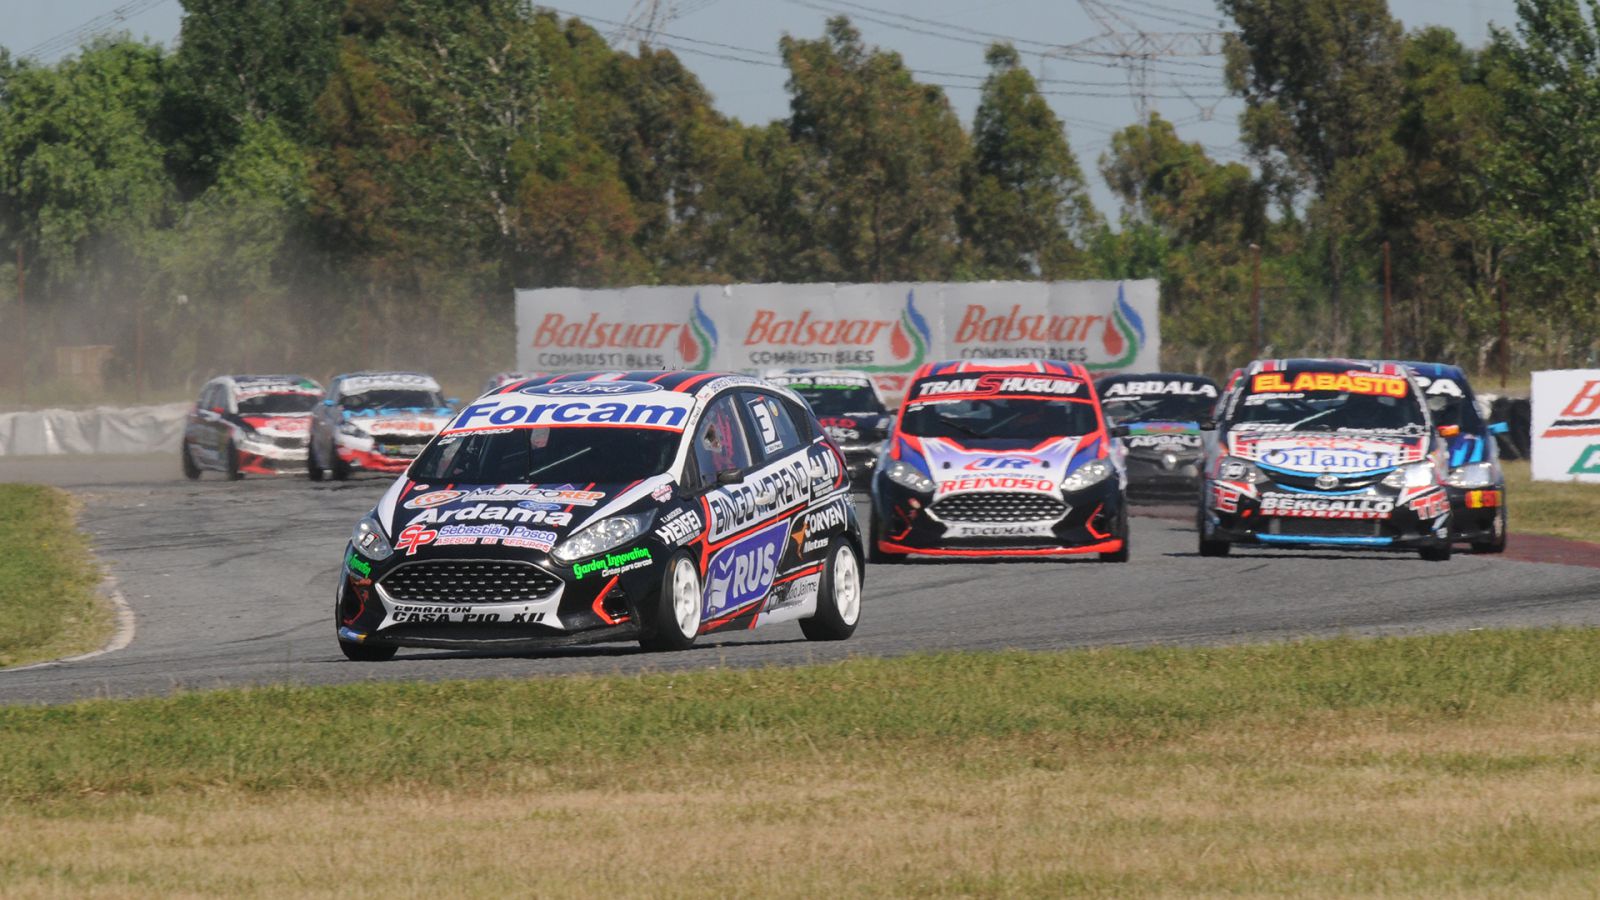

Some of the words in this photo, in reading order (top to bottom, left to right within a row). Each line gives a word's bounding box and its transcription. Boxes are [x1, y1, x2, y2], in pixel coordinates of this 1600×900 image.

[532, 312, 682, 348] Balsuar
[743, 310, 891, 346] Balsuar
[953, 304, 1104, 344] Balsuar
[538, 351, 664, 367] COMBUSTIBLES
[750, 350, 875, 365] COMBUSTIBLES
[961, 347, 1089, 362] COMBUSTIBLES
[548, 382, 627, 393] Ford
[1103, 380, 1218, 398] ABDALA
[1254, 374, 1291, 391] EL
[1293, 371, 1405, 396] ABASTO
[452, 401, 688, 429] Forcam
[752, 402, 777, 445] 3
[1260, 450, 1394, 468] Orlandi
[940, 478, 1054, 494] REINOSO
[405, 502, 573, 527] Ardama
[1259, 498, 1395, 513] BERGALLO
[803, 500, 846, 538] CORVEN
[396, 525, 436, 555] SP
[439, 524, 508, 537] Sebastián
[512, 526, 556, 542] Posco
[481, 537, 498, 546] DE
[573, 559, 607, 580] Garden
[606, 546, 652, 568] Innovation
[732, 541, 776, 599] RUS
[391, 611, 450, 623] CASA
